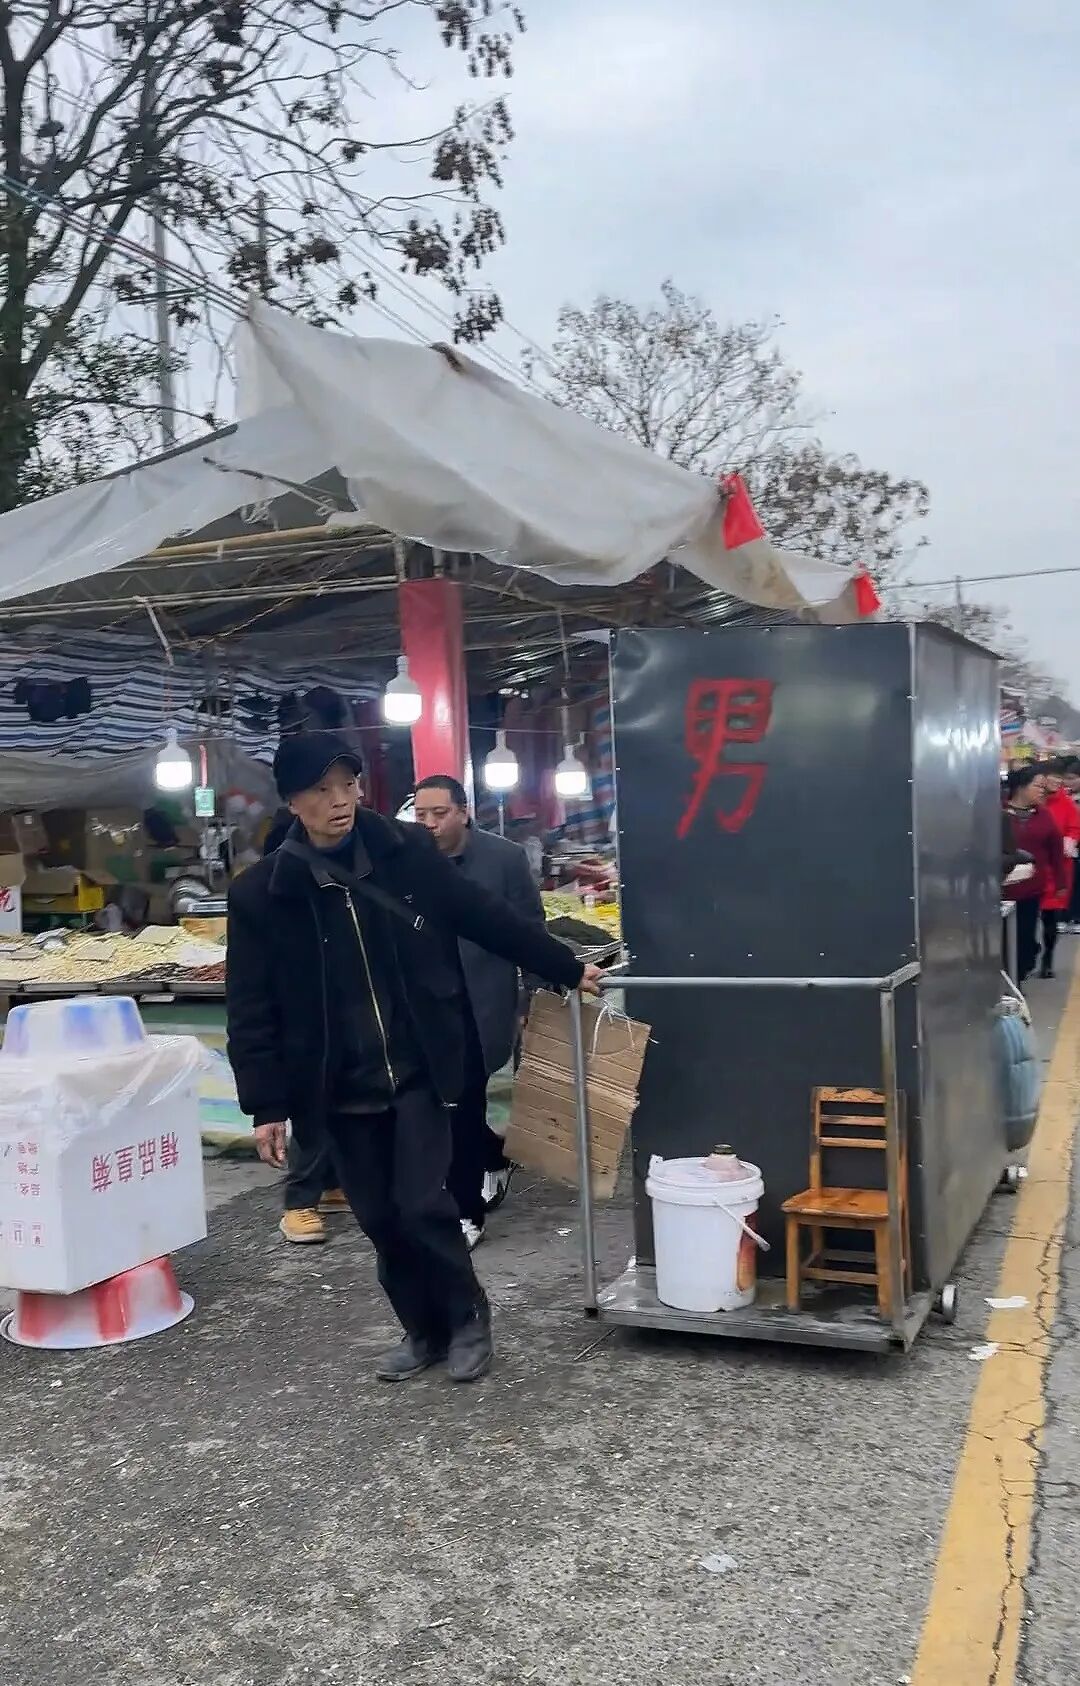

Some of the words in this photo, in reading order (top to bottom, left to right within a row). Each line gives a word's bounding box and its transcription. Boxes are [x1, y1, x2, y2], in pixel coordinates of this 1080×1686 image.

[676, 677, 774, 839] 男
[91, 1131, 179, 1193] 精品皇菊
